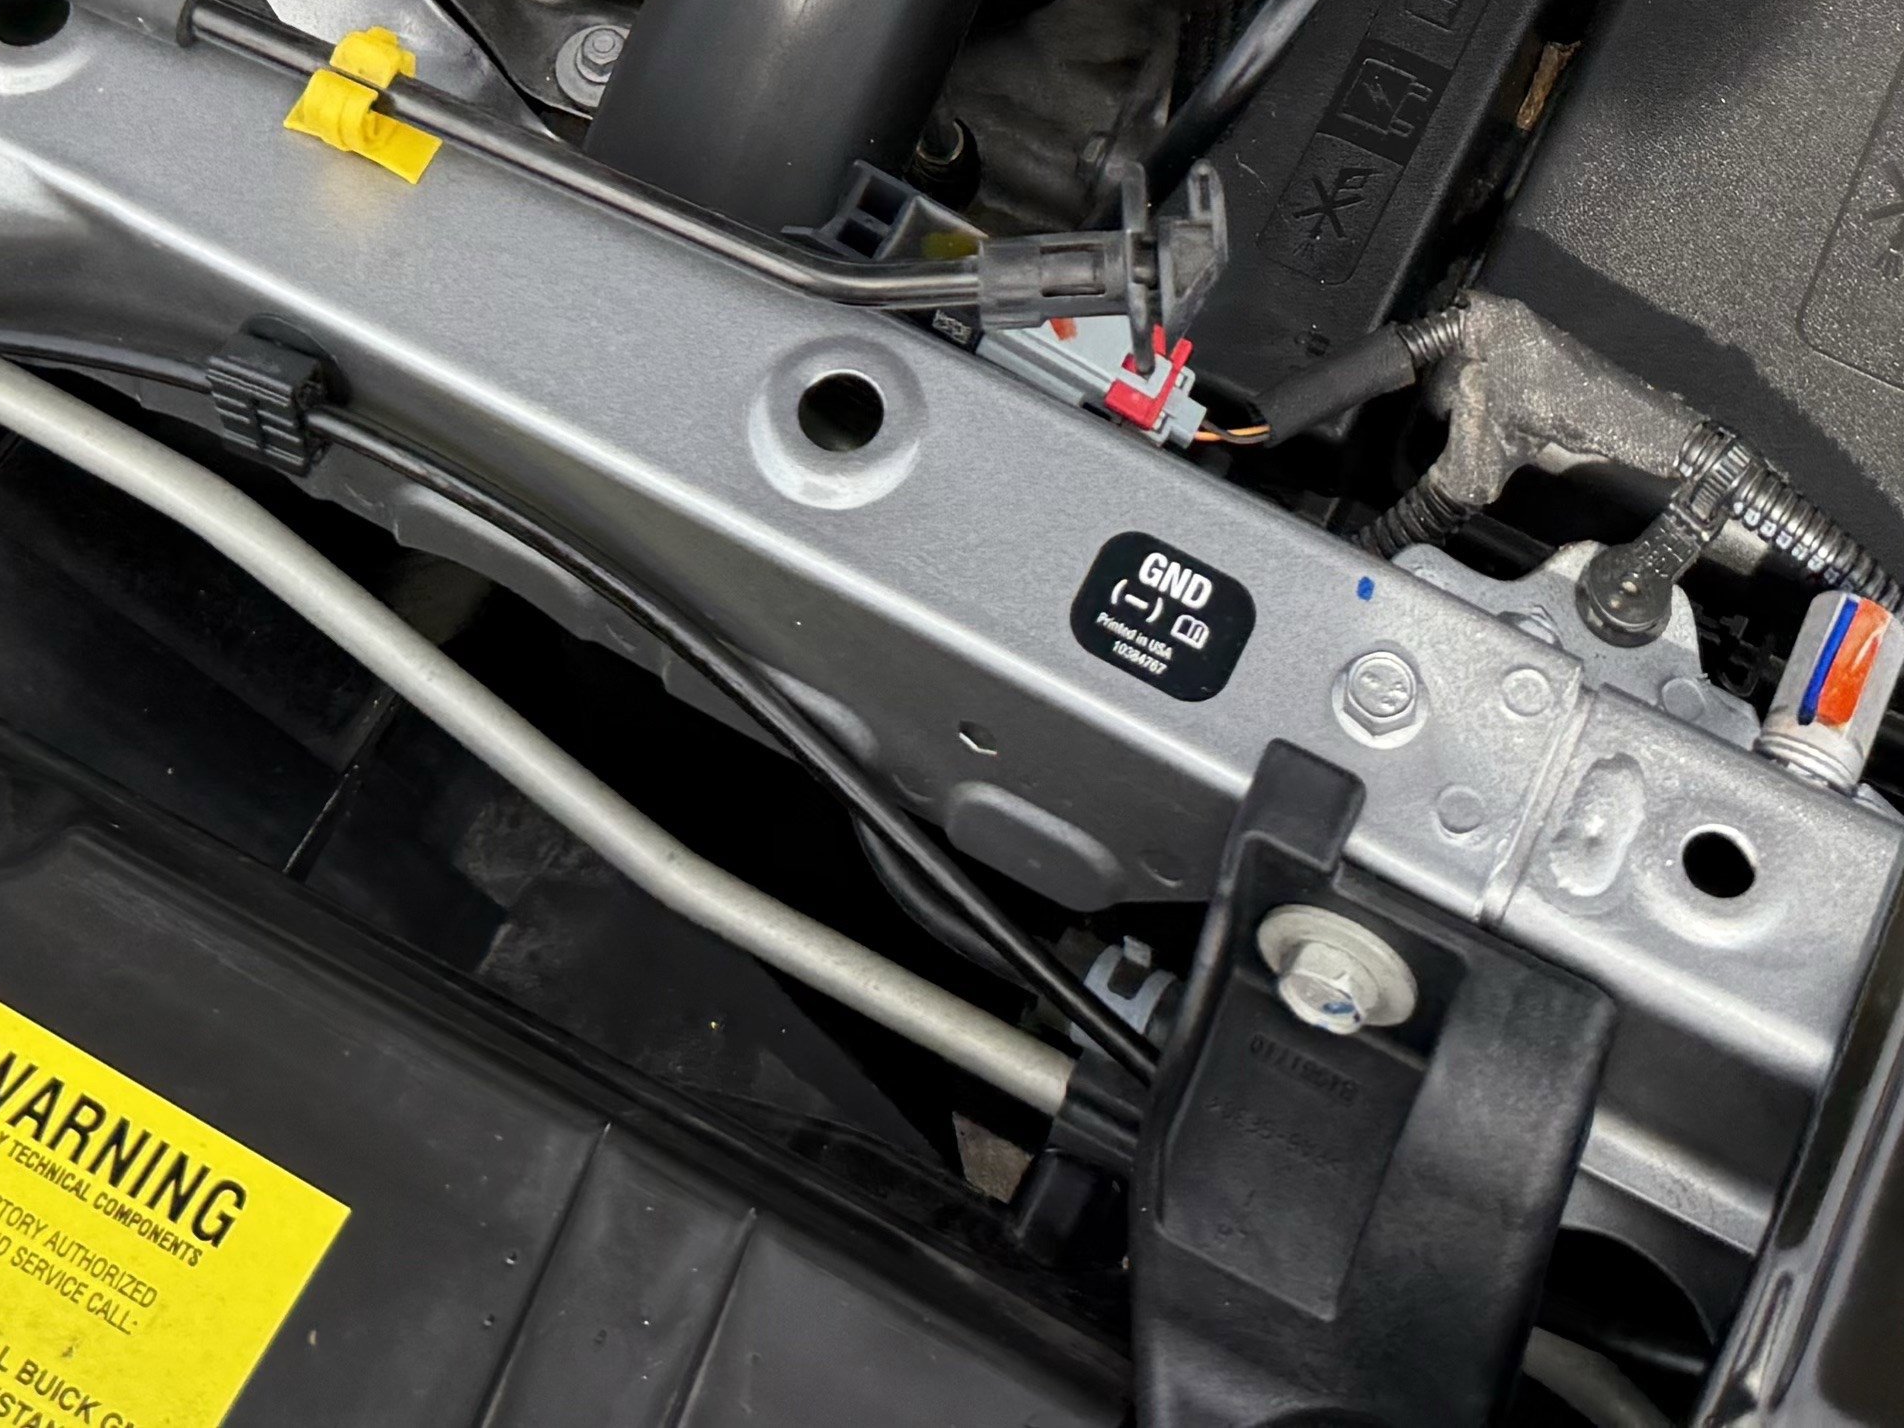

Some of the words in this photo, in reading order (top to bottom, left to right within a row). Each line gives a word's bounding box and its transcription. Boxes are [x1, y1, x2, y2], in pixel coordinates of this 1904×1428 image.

[1135, 551, 1213, 608] GND
[1094, 610, 1137, 641] Printed
[1134, 631, 1149, 647] in
[1147, 638, 1173, 661] USA
[7, 1138, 89, 1202] TECHNICAL
[94, 1190, 202, 1267] COMPONENTS
[9, 1246, 95, 1306] SERVICE
[87, 1292, 138, 1335] CALL:
[45, 1230, 158, 1309] AUTHORIZED
[15, 1358, 102, 1425] BUICK
